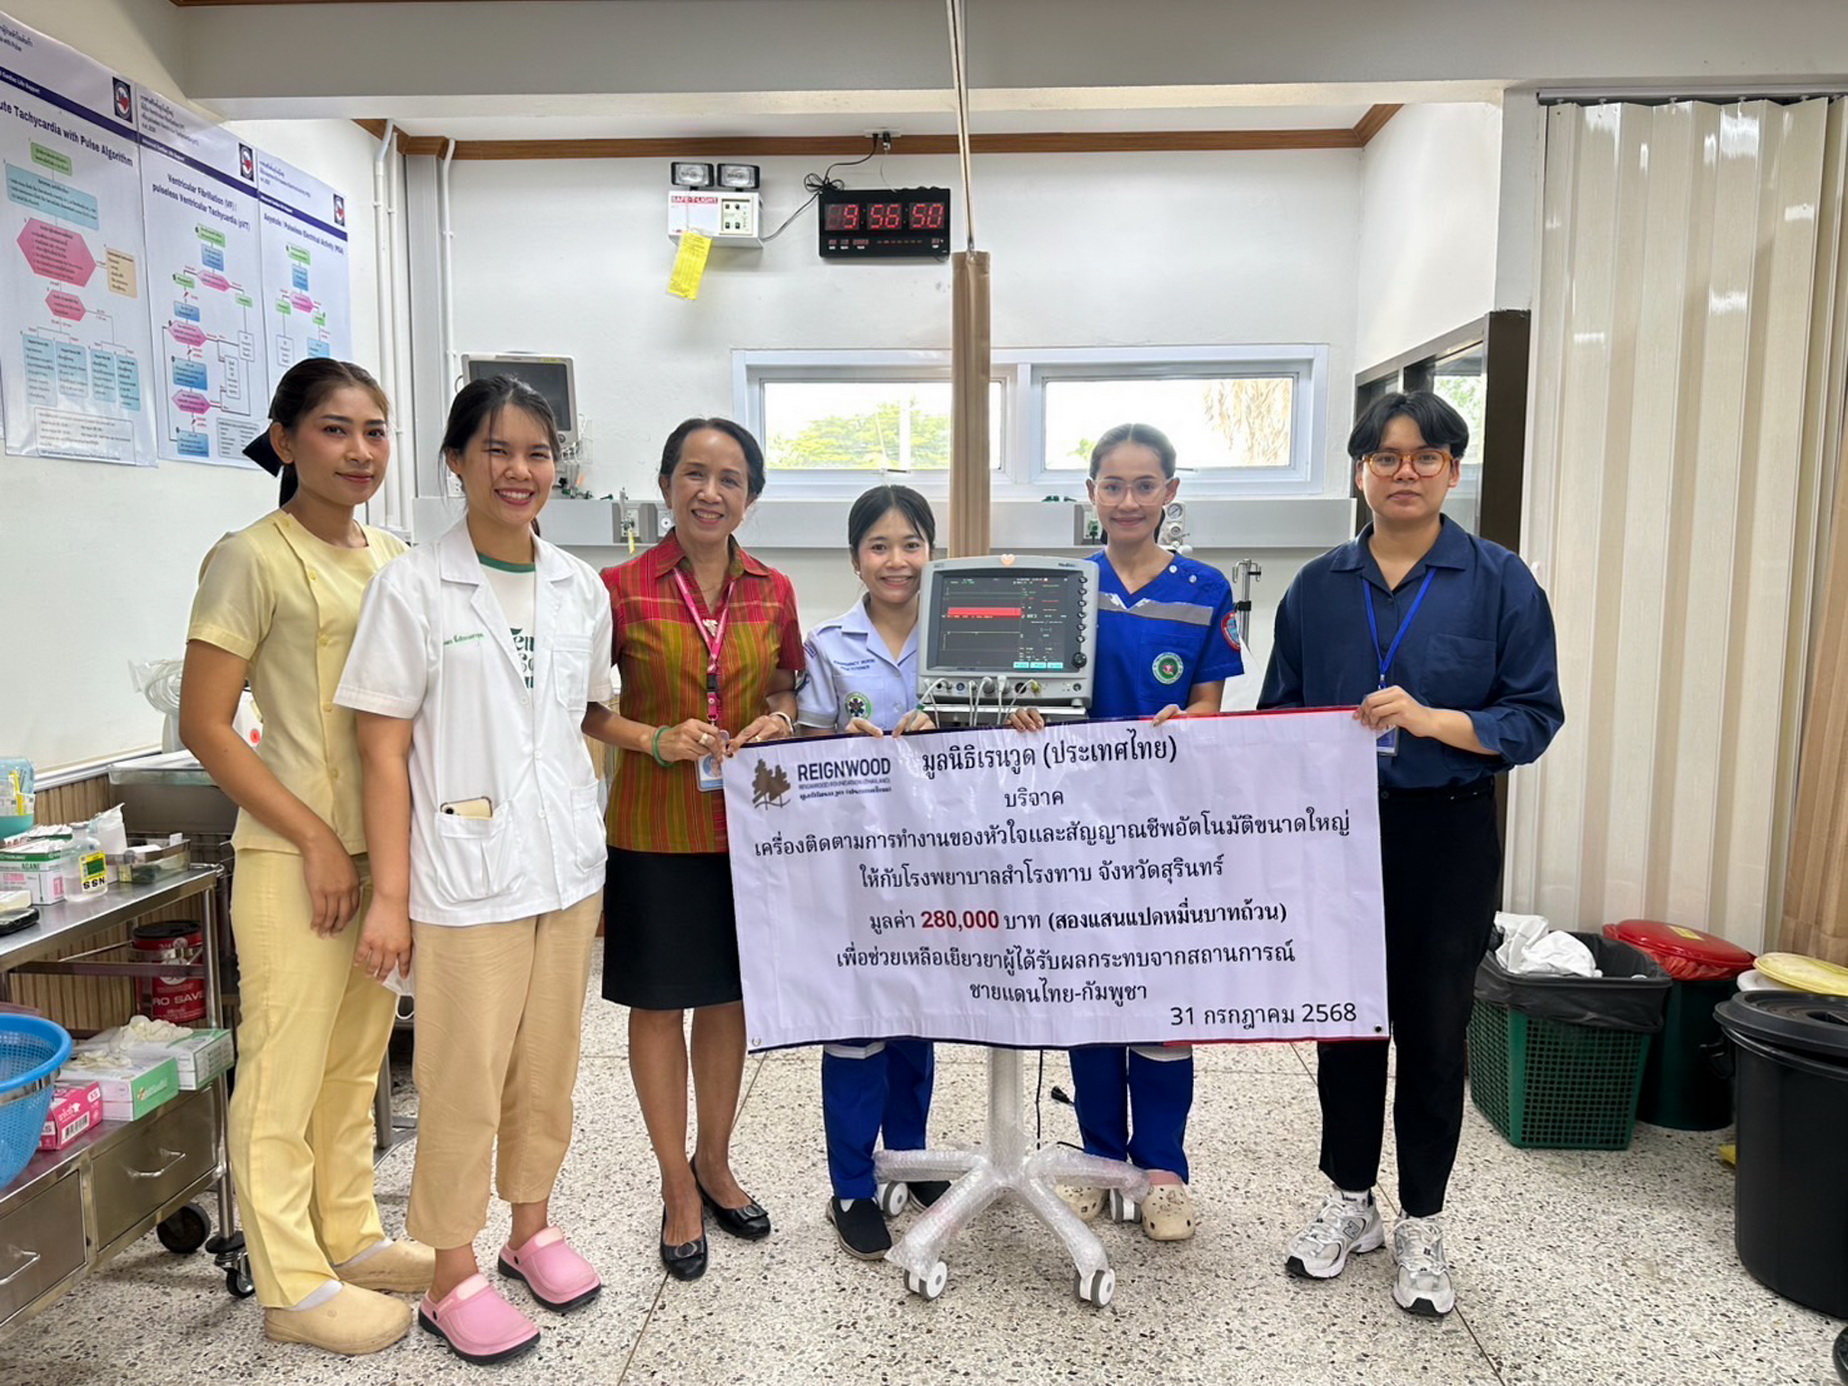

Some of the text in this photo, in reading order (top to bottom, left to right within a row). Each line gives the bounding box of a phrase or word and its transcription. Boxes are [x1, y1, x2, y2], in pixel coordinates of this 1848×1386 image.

[14, 105, 62, 136] Tachycardia
[63, 129, 79, 143] with
[81, 135, 100, 152] Pulse
[101, 144, 133, 167] Algorithm
[152, 183, 179, 200] pulseless
[179, 193, 207, 213] Ventricular
[208, 205, 237, 225] Tachycardia
[167, 173, 197, 193] Ventricular
[197, 186, 224, 205] Fibrillation
[797, 757, 891, 781] REIGNWOOD
[922, 728, 1177, 780] มูลนิธิเรนวูด (ประเทศไทย)
[1004, 787, 1064, 808] บริจาค
[755, 806, 1350, 856] เครื่องติดตามการทำงานของหัวใจและสัญญาณชีพอัตโนมัติขนาดใหญ่
[860, 854, 1224, 888] ให้กับโรงพยาบาลสำโรงทาบ จังหวัดสุรินทร์
[870, 898, 1287, 935] มูลค่า 280,000 บาท (สองแสนแปดหมื่นบาทถ้วน)
[837, 939, 1296, 976] เพื่อช่วยเหลือเยียวยาผู้ได้รับผลกระทบจากสถานการณ์
[970, 977, 1148, 1007] ชายแดนไทย-กัมพูชา
[1171, 1002, 1358, 1030] 31 กรกฎาคม 2568
